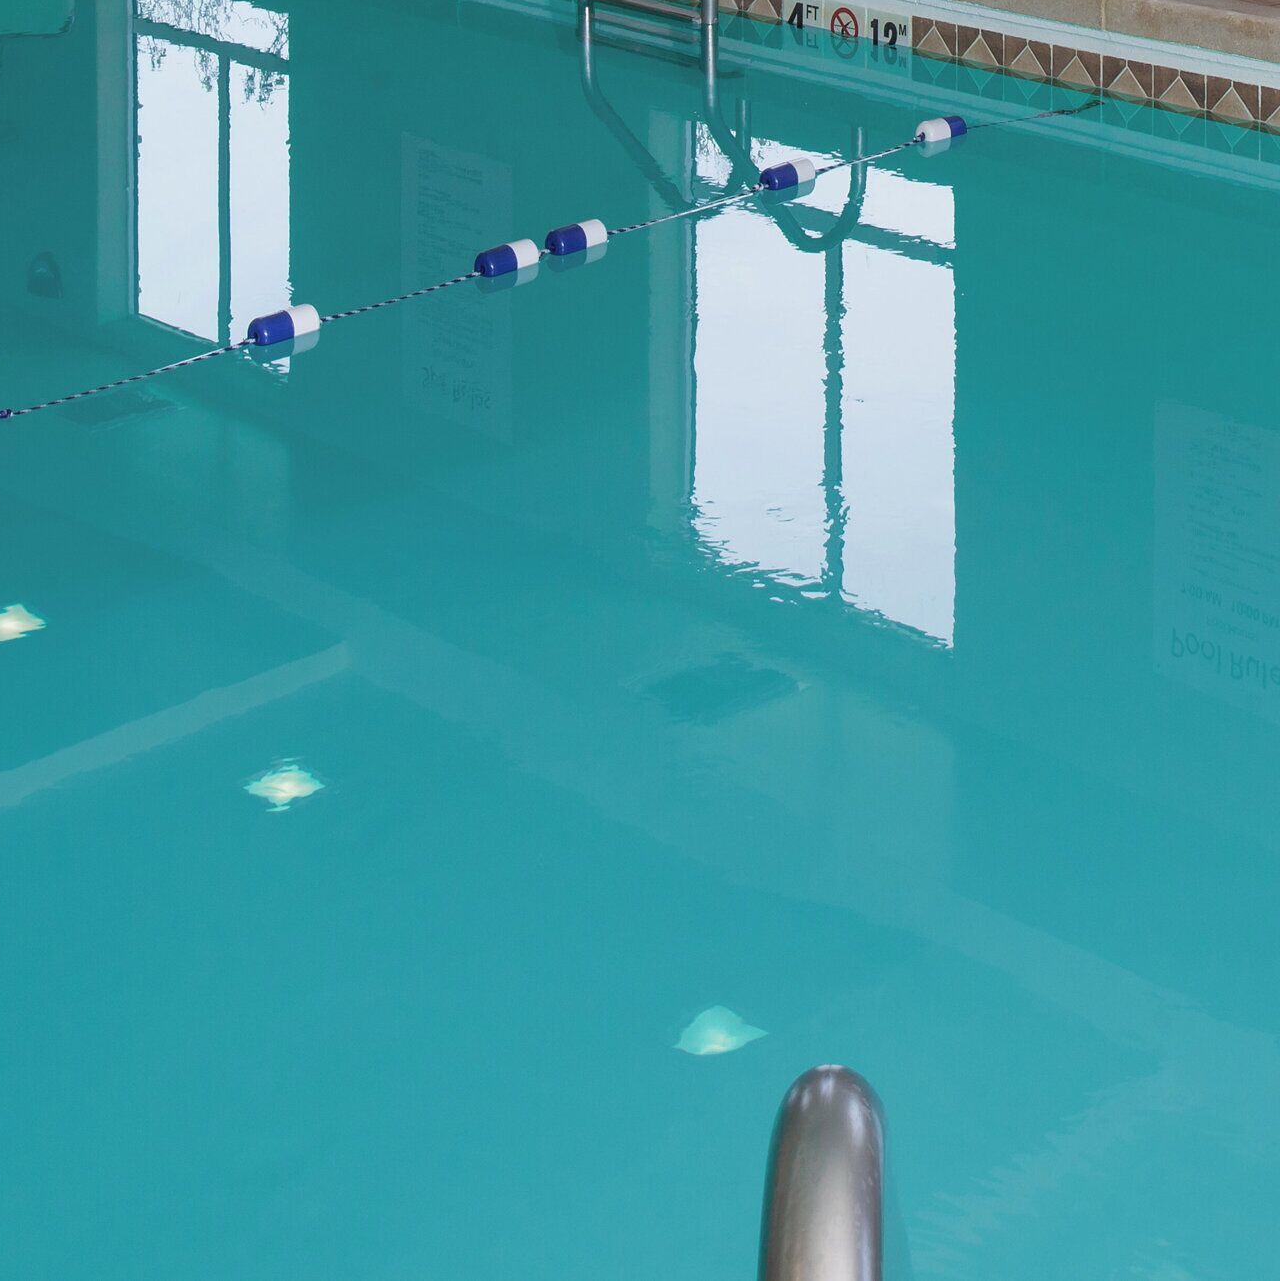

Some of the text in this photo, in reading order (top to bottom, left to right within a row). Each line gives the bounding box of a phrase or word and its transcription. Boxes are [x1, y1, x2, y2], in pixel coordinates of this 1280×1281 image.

[787, 2, 907, 46] 4 FT 12 M
